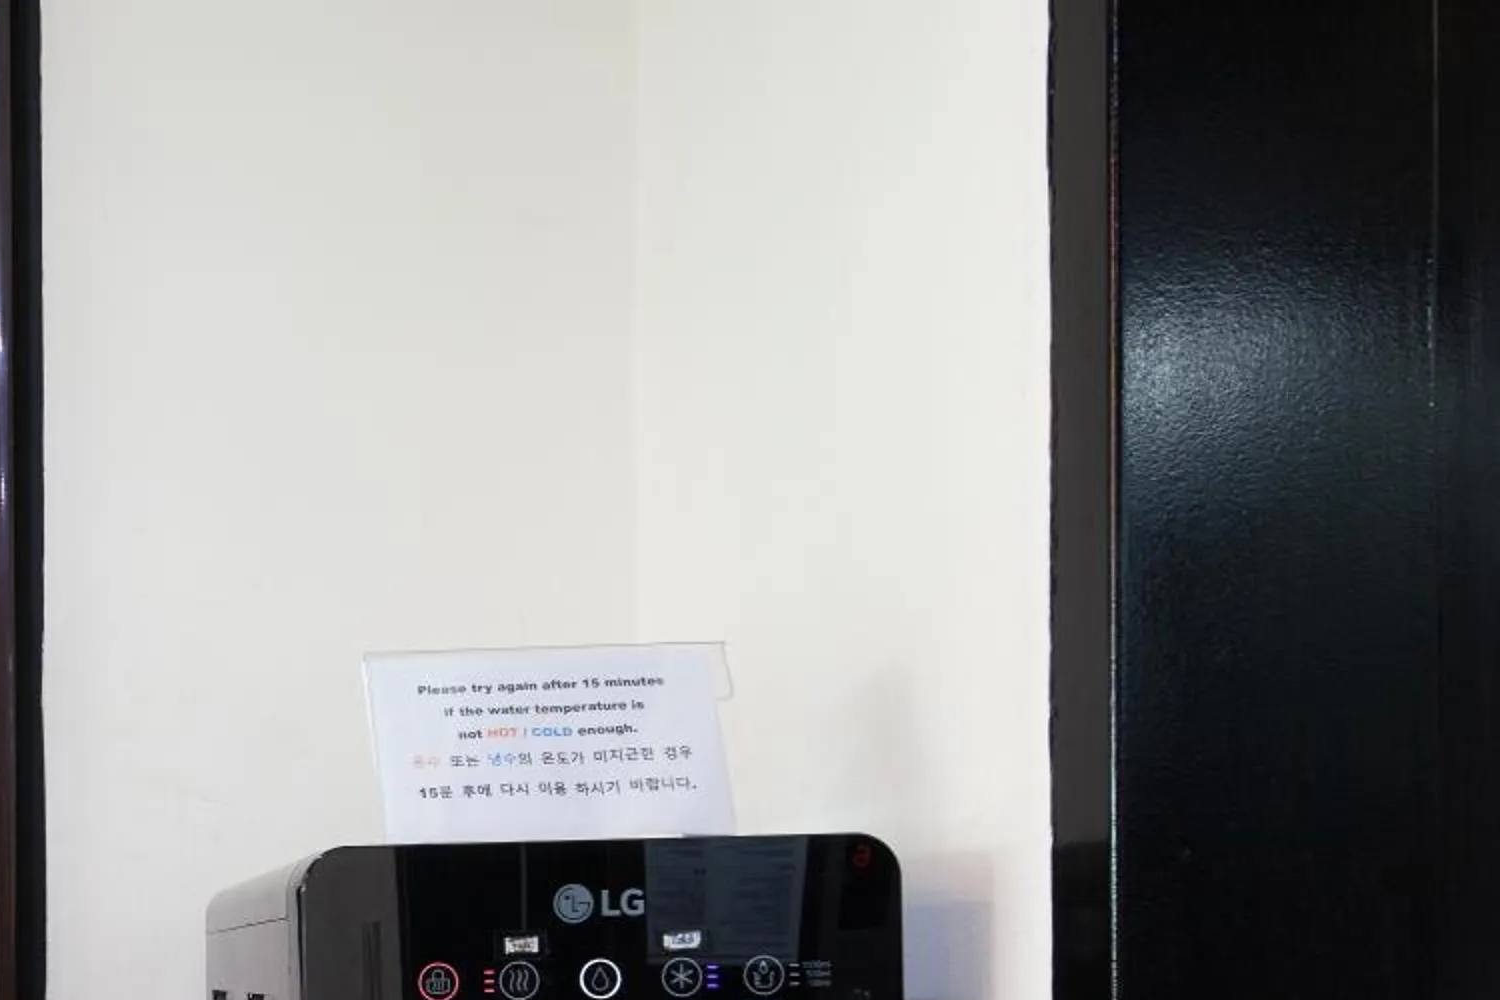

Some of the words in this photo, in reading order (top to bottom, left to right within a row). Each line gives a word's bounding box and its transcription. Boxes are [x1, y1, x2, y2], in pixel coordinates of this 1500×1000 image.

[417, 684, 467, 695] Please
[471, 684, 493, 694] try
[497, 682, 538, 693] again
[542, 679, 577, 691] after
[582, 678, 600, 689] 15
[604, 676, 665, 687] minutes
[444, 706, 455, 717] if
[459, 706, 483, 717] the
[488, 705, 530, 715] water
[535, 701, 627, 715] temperature
[631, 699, 645, 710] is
[457, 729, 483, 740] not
[487, 727, 517, 737] HOT
[531, 727, 573, 737] COLD
[577, 723, 638, 736] enough.
[450, 754, 481, 767] 또는
[540, 751, 585, 765] 온도가
[593, 747, 654, 762] 미지근한
[499, 783, 529, 796] 다시
[539, 781, 567, 796] 이용
[600, 888, 645, 917] LG
